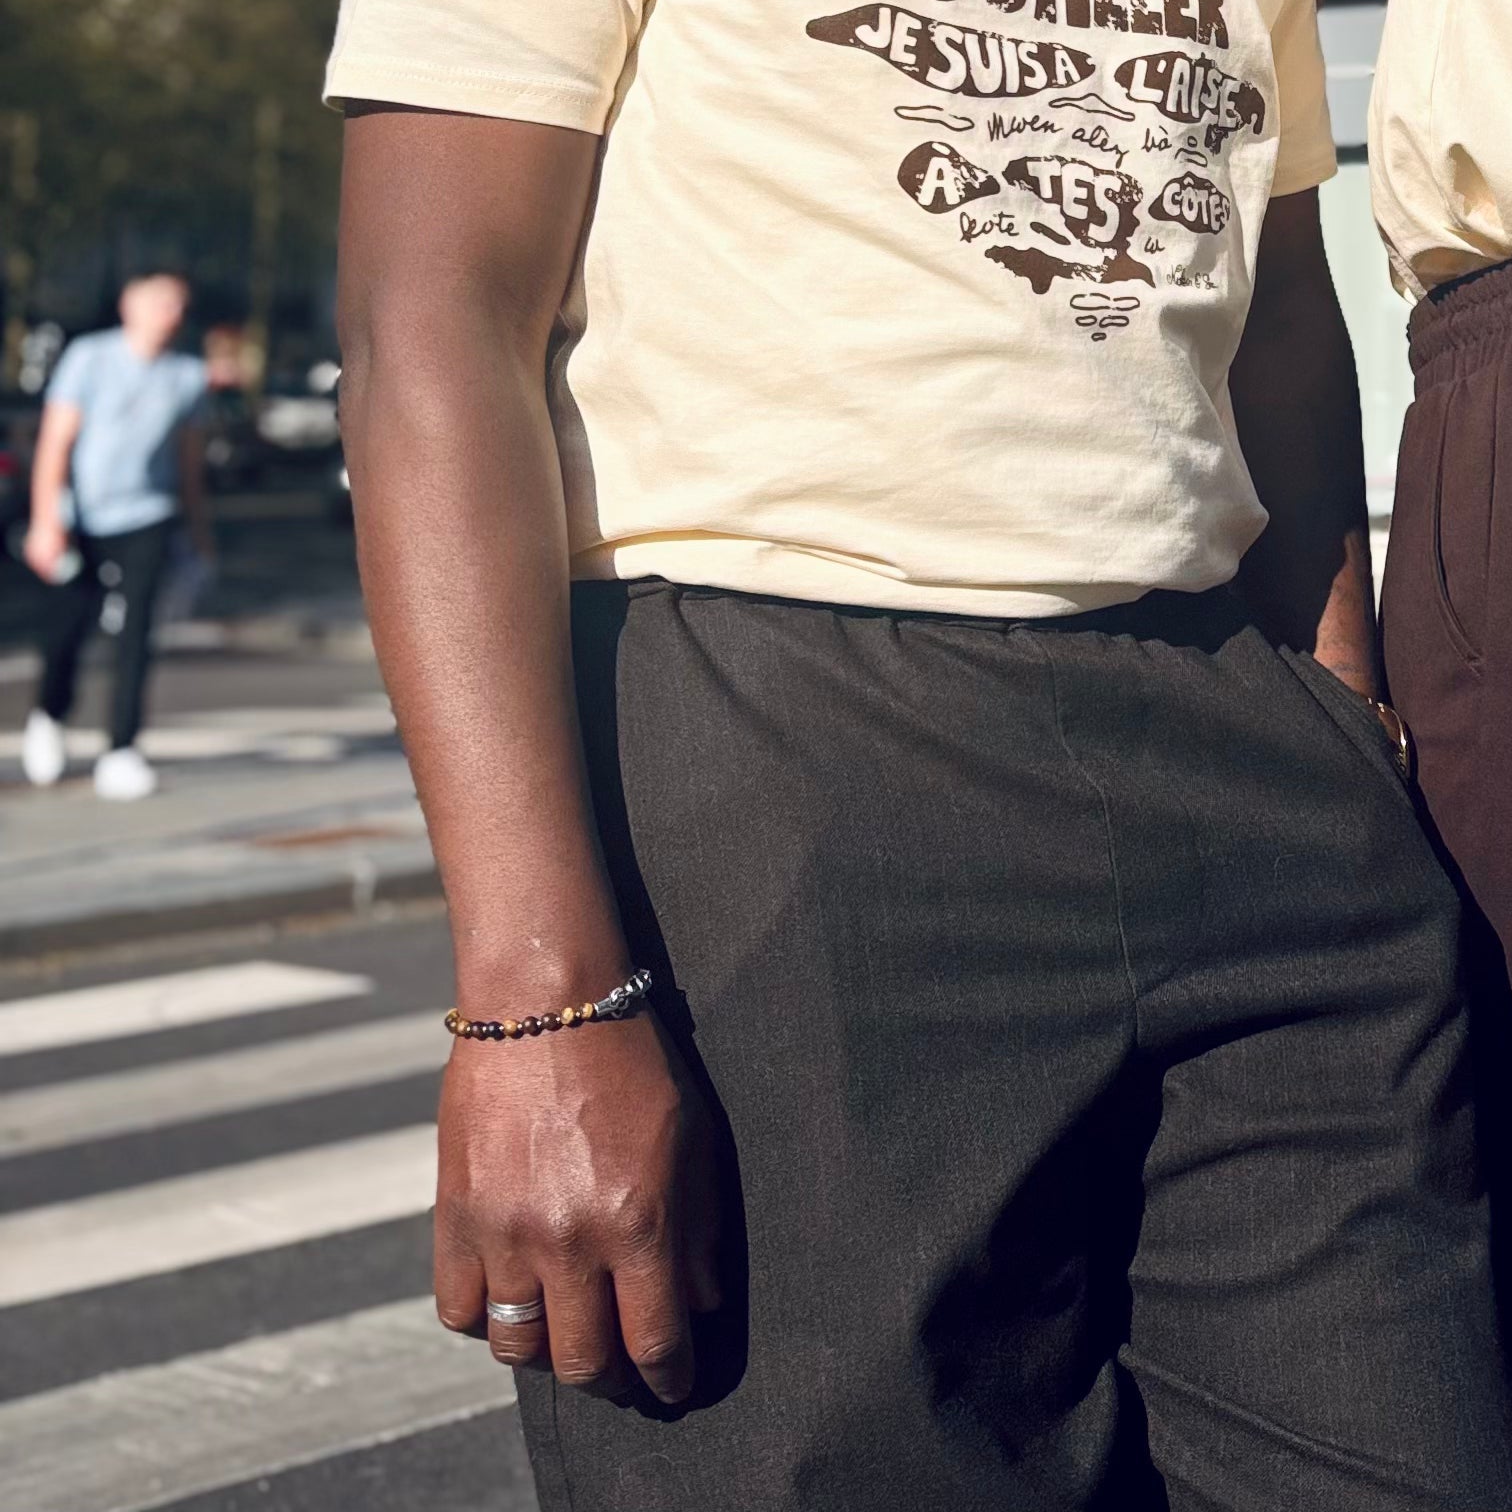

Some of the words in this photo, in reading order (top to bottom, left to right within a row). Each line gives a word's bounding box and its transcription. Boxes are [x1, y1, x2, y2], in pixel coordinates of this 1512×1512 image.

[854, 6, 923, 66] JE
[925, 23, 1049, 95] SUIS
[1129, 57, 1243, 129] L'AISE
[1025, 159, 1124, 243] TES
